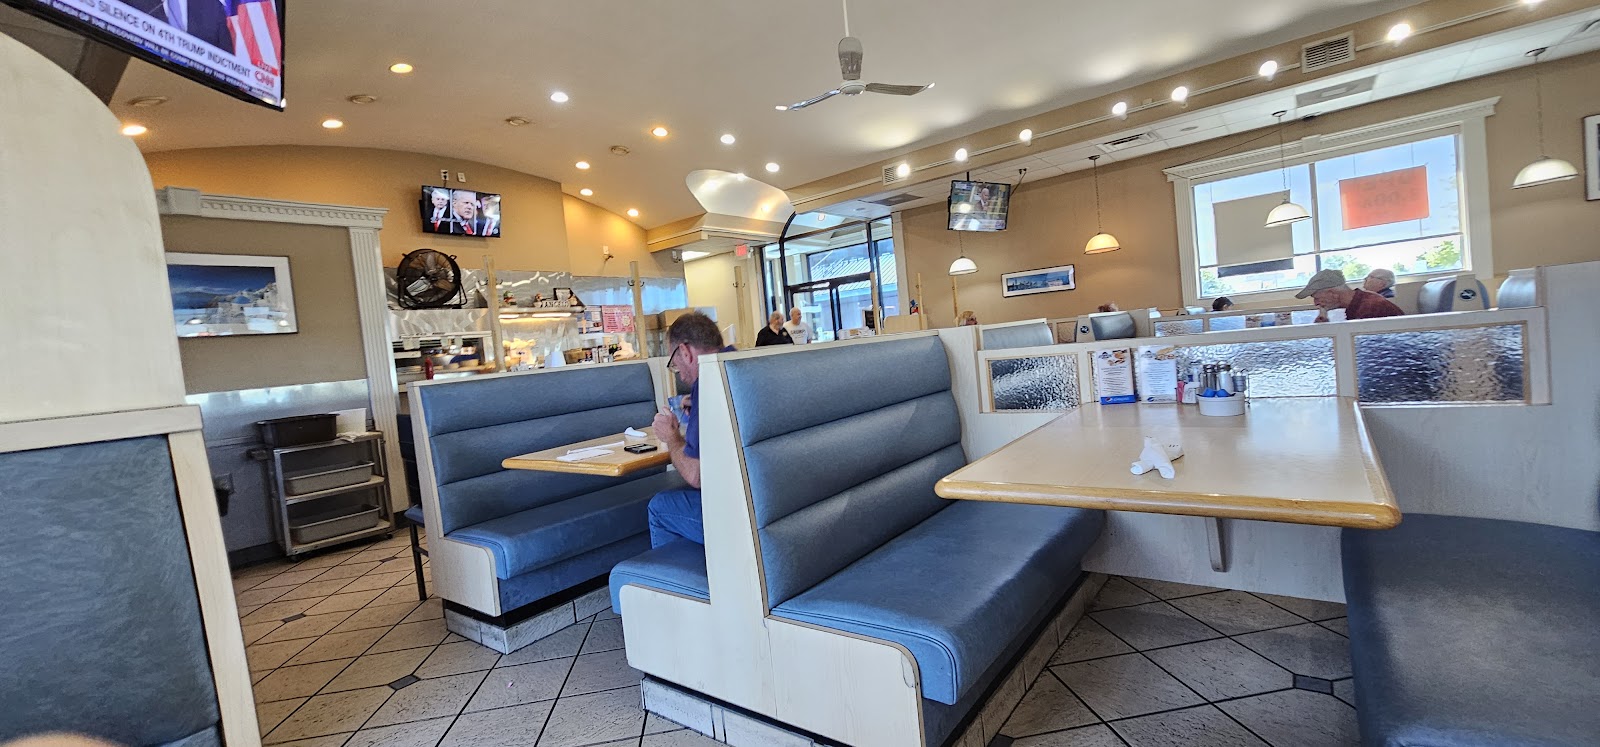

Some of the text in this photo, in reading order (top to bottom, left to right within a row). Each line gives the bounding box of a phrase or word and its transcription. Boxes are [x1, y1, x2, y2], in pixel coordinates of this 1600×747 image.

[97, 0, 252, 78] SILENCE ON 4TH TRUMP INDICTMENT
[255, 69, 275, 88] CNN
